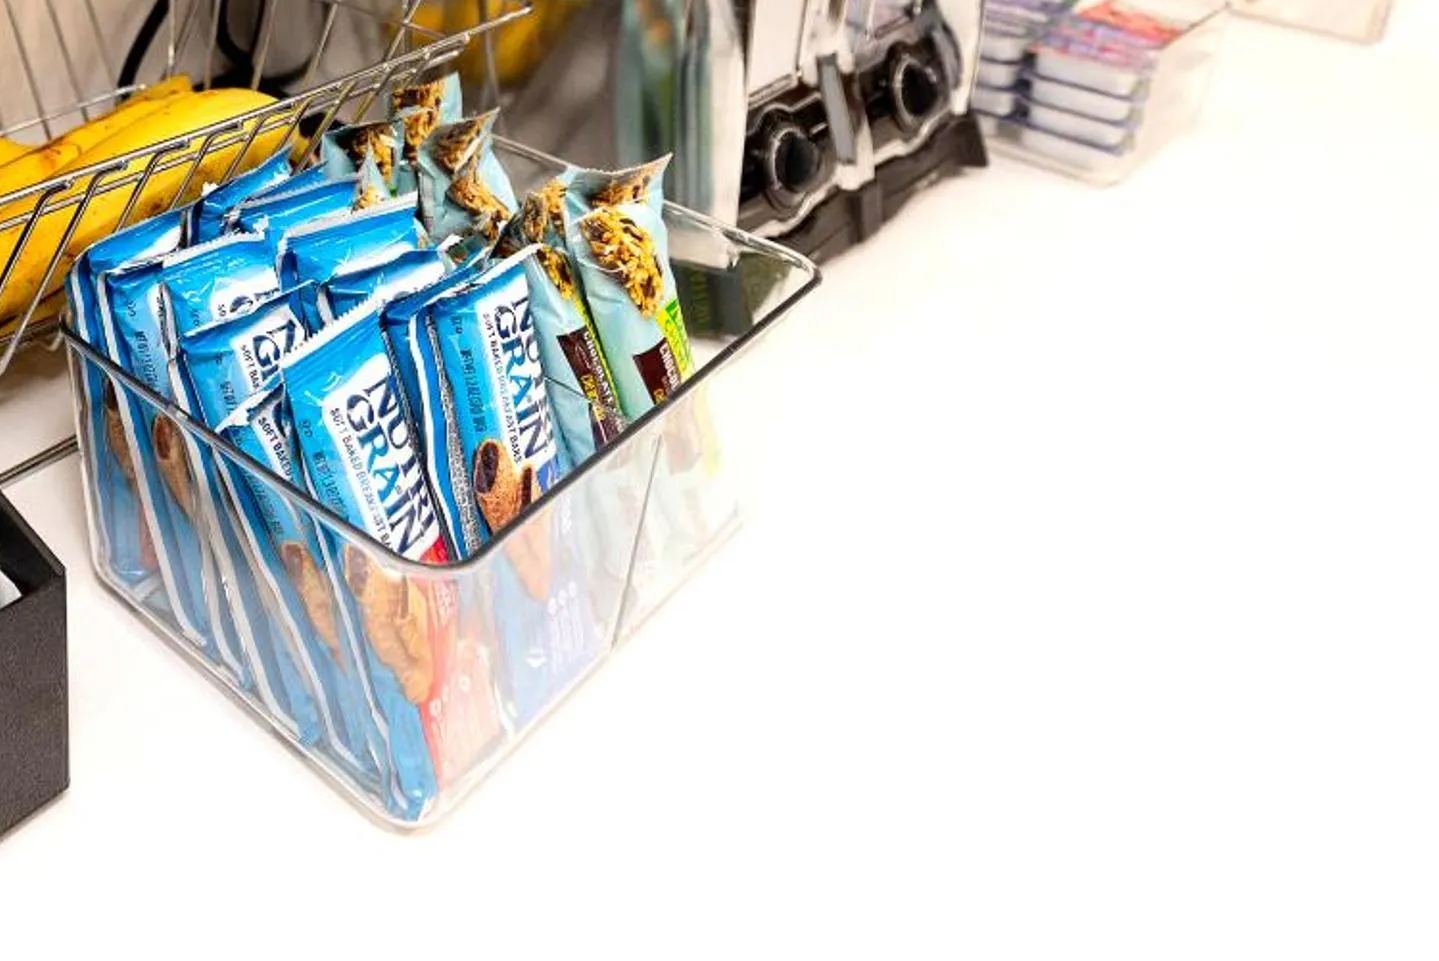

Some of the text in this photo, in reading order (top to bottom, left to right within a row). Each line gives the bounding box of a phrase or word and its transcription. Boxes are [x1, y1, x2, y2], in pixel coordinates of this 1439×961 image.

[257, 415, 294, 478] SOFT BAKED
[363, 372, 437, 534] NUTRI
[494, 306, 549, 459] GRAIN
[346, 394, 426, 555] GRAIN
